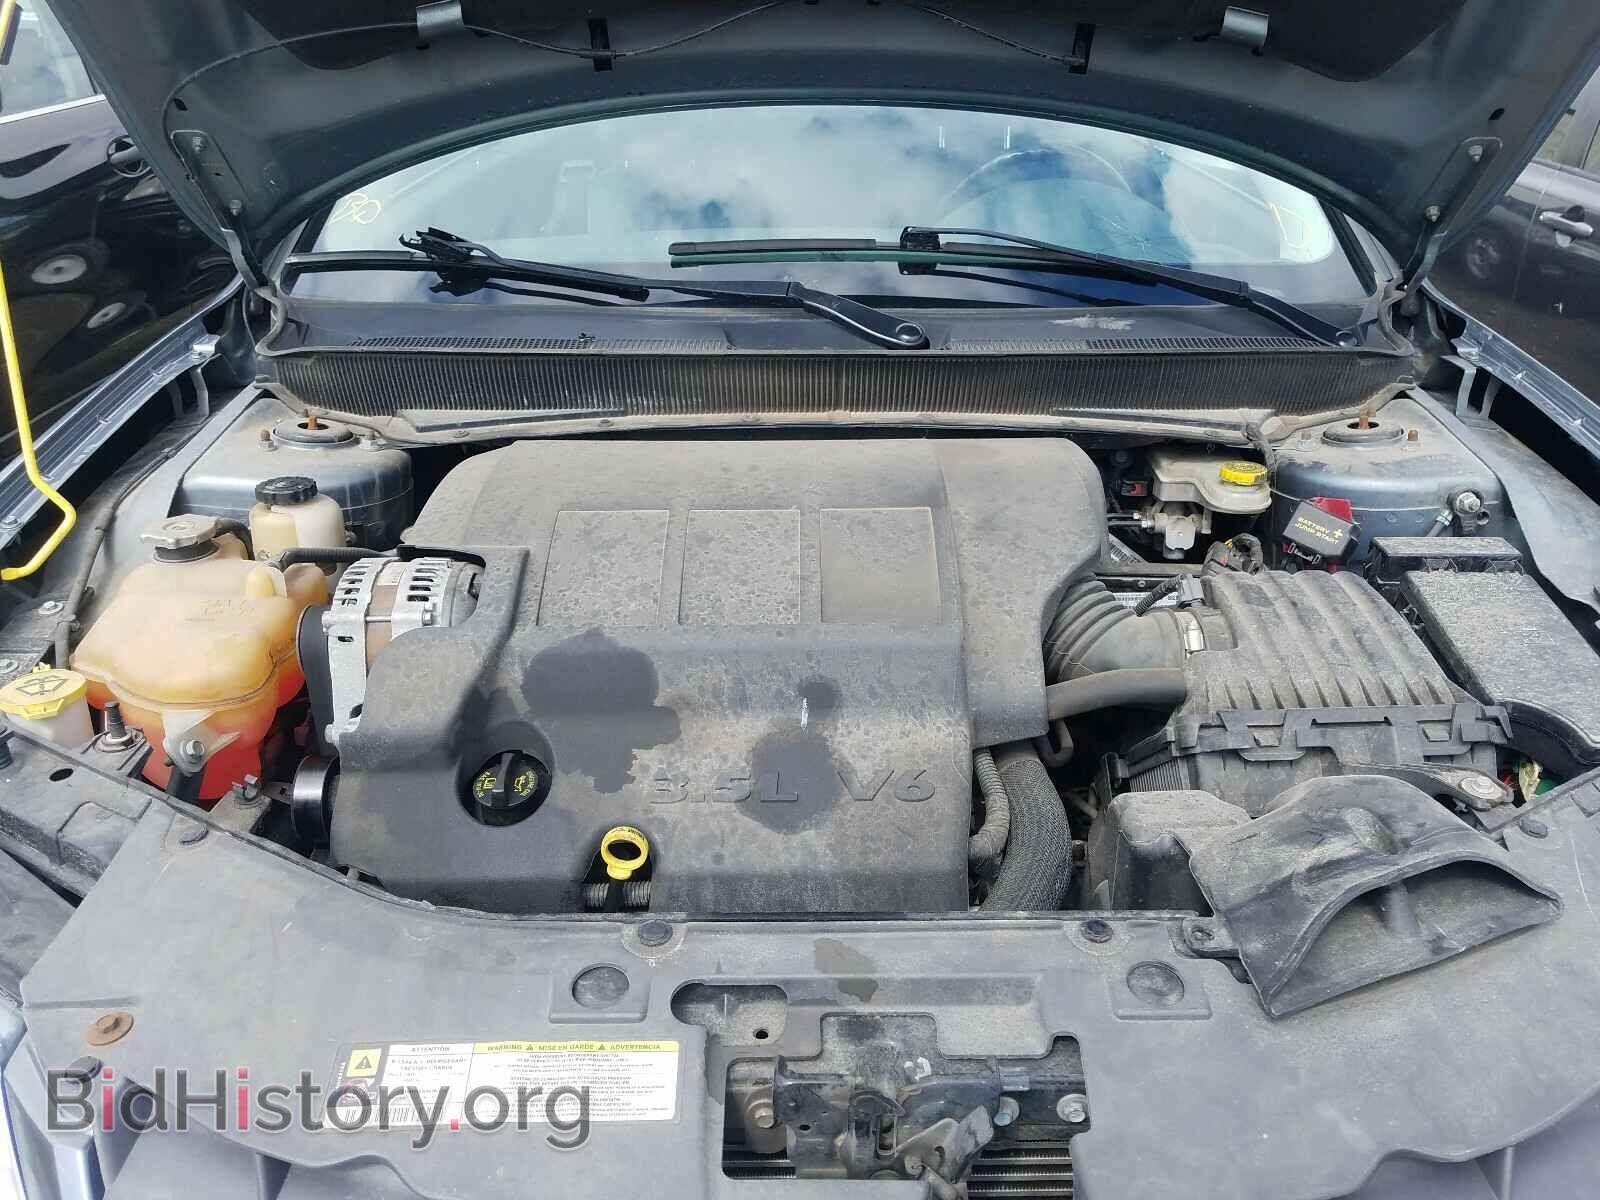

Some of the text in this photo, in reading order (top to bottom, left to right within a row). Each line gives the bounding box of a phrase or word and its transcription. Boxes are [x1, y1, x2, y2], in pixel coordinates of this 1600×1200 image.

[1294, 523, 1339, 545] JUMP START
[1297, 517, 1331, 534] BATTERY
[649, 768, 937, 804] 3.5L V6
[487, 1043, 523, 1052] WARNING
[538, 1043, 558, 1051] MISE
[569, 1043, 595, 1051] GARDE
[610, 1043, 662, 1051] ADVERTENCIA
